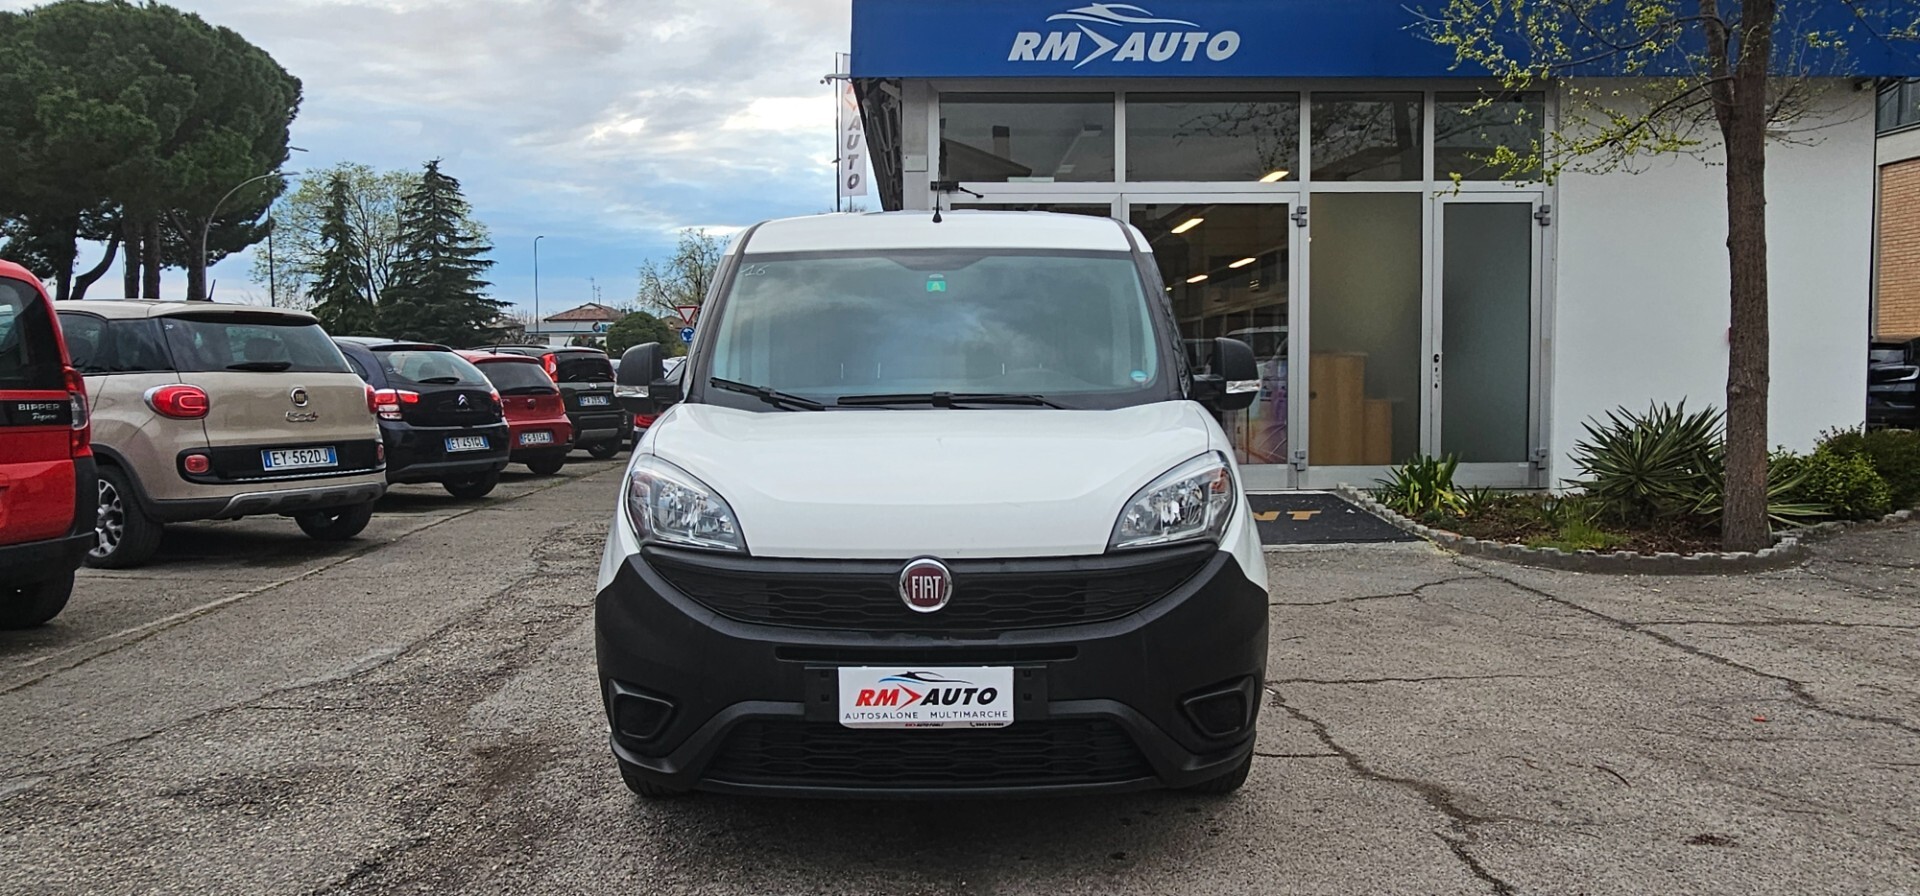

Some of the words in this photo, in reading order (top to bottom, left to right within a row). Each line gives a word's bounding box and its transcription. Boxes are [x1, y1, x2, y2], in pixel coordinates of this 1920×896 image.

[1007, 31, 1082, 62] RM
[1111, 30, 1241, 63] AUTO
[846, 115, 861, 190] AUTO
[18, 403, 60, 411] BIPPER
[450, 437, 460, 448] ET
[271, 451, 287, 466] EY
[292, 449, 328, 464] 562DJ
[911, 575, 942, 600] FIAT
[855, 688, 900, 707] RM
[919, 687, 998, 706] AUTO
[845, 711, 919, 720] AUTOSALONE
[930, 710, 1008, 720] MULTIMARCHE
